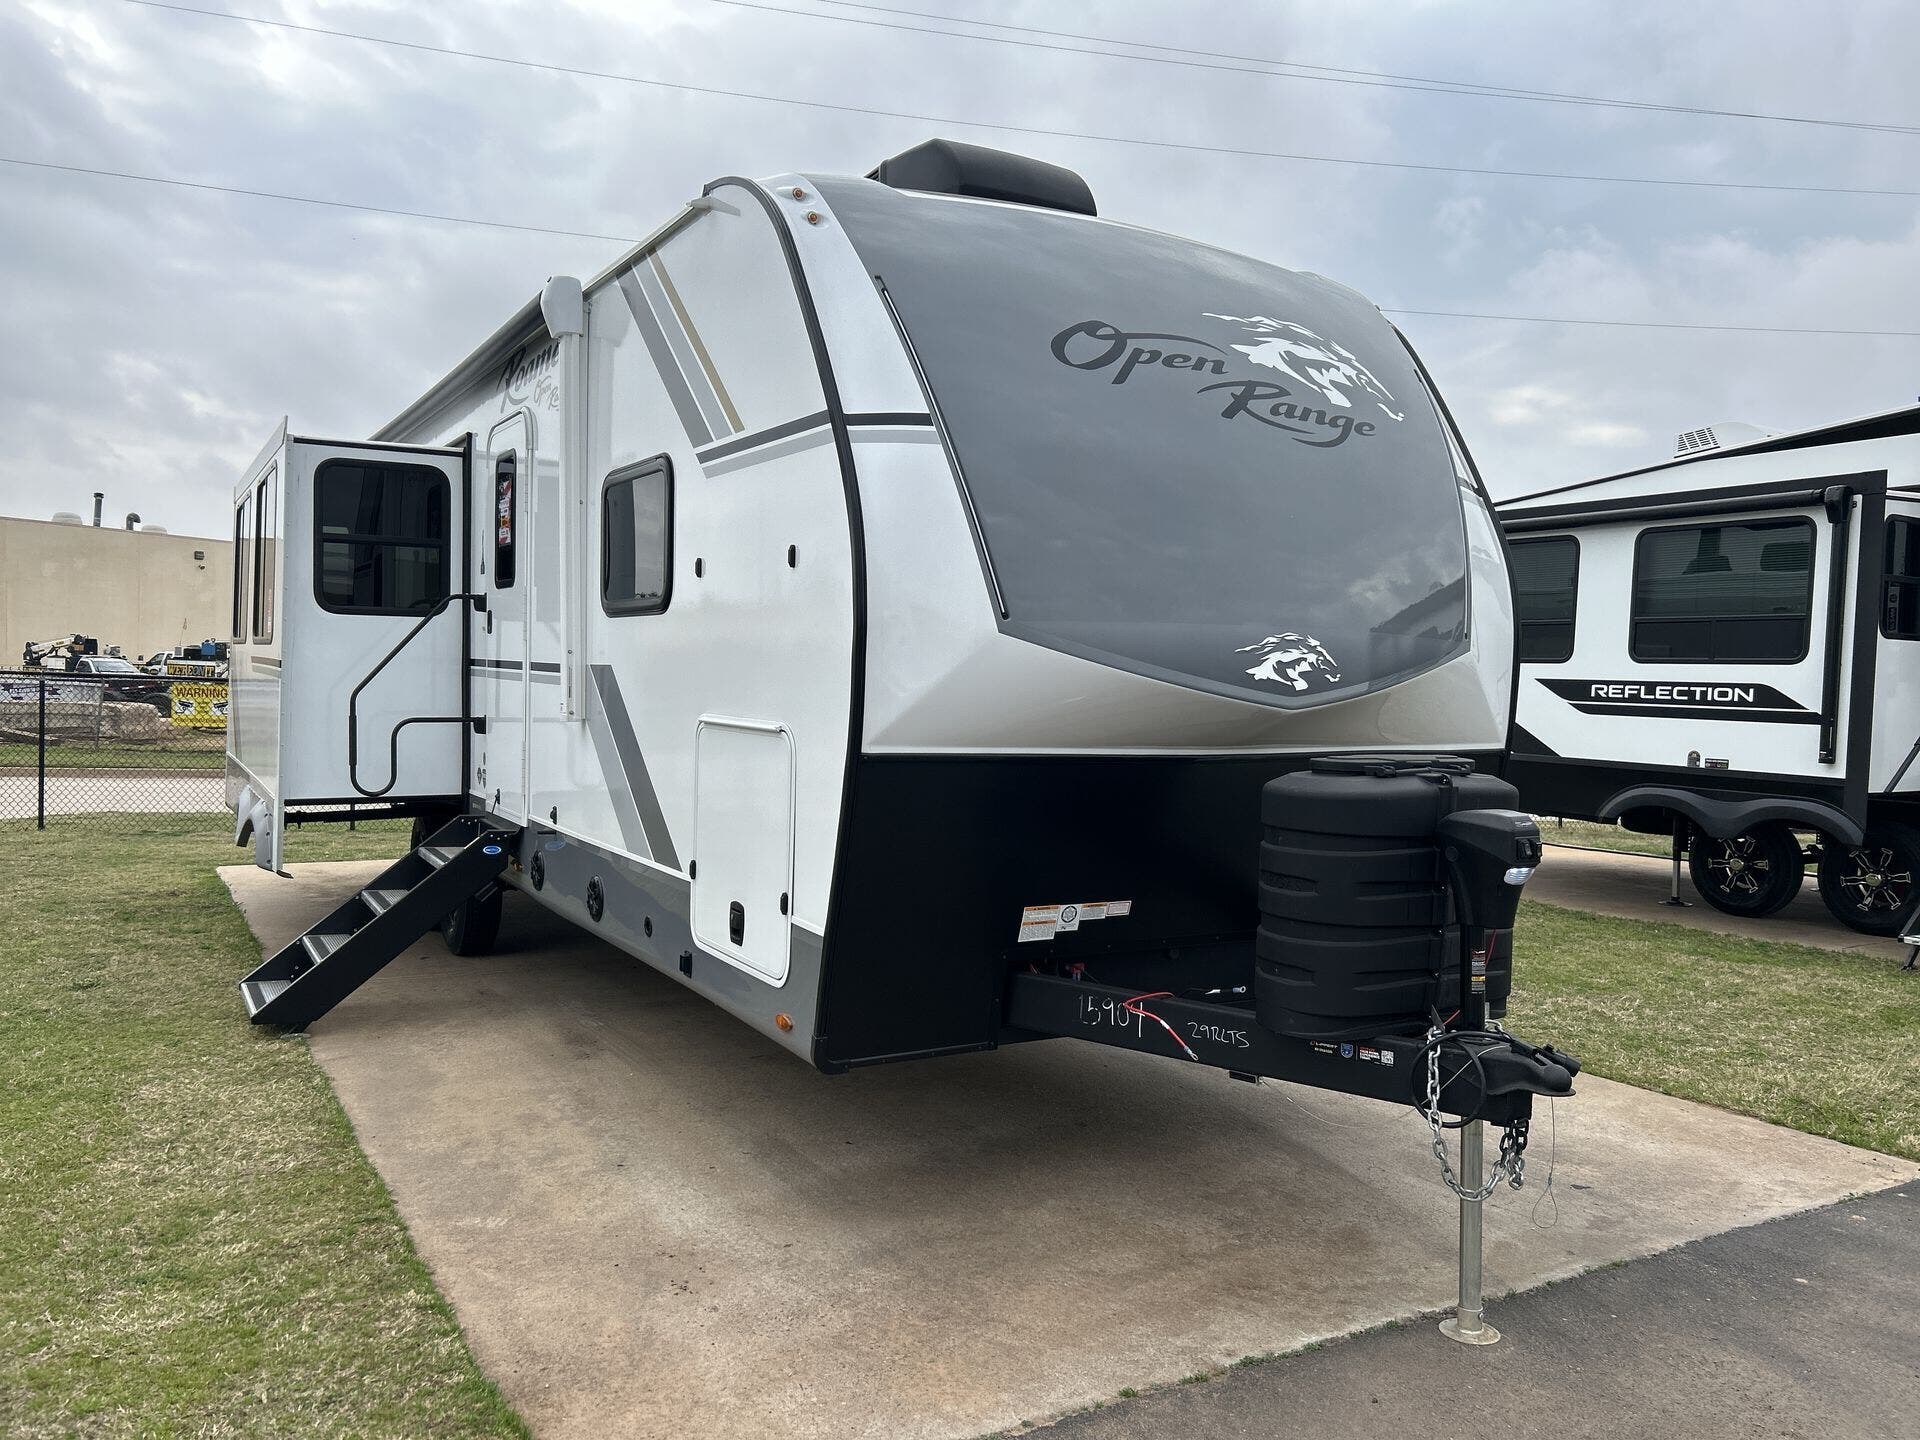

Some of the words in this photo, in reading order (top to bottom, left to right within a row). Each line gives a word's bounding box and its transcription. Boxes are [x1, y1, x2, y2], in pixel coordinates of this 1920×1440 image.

[1050, 319, 1228, 385] Open
[1197, 379, 1377, 448] Range
[176, 687, 228, 698] WARNING
[1590, 683, 1755, 703] REFLECTION
